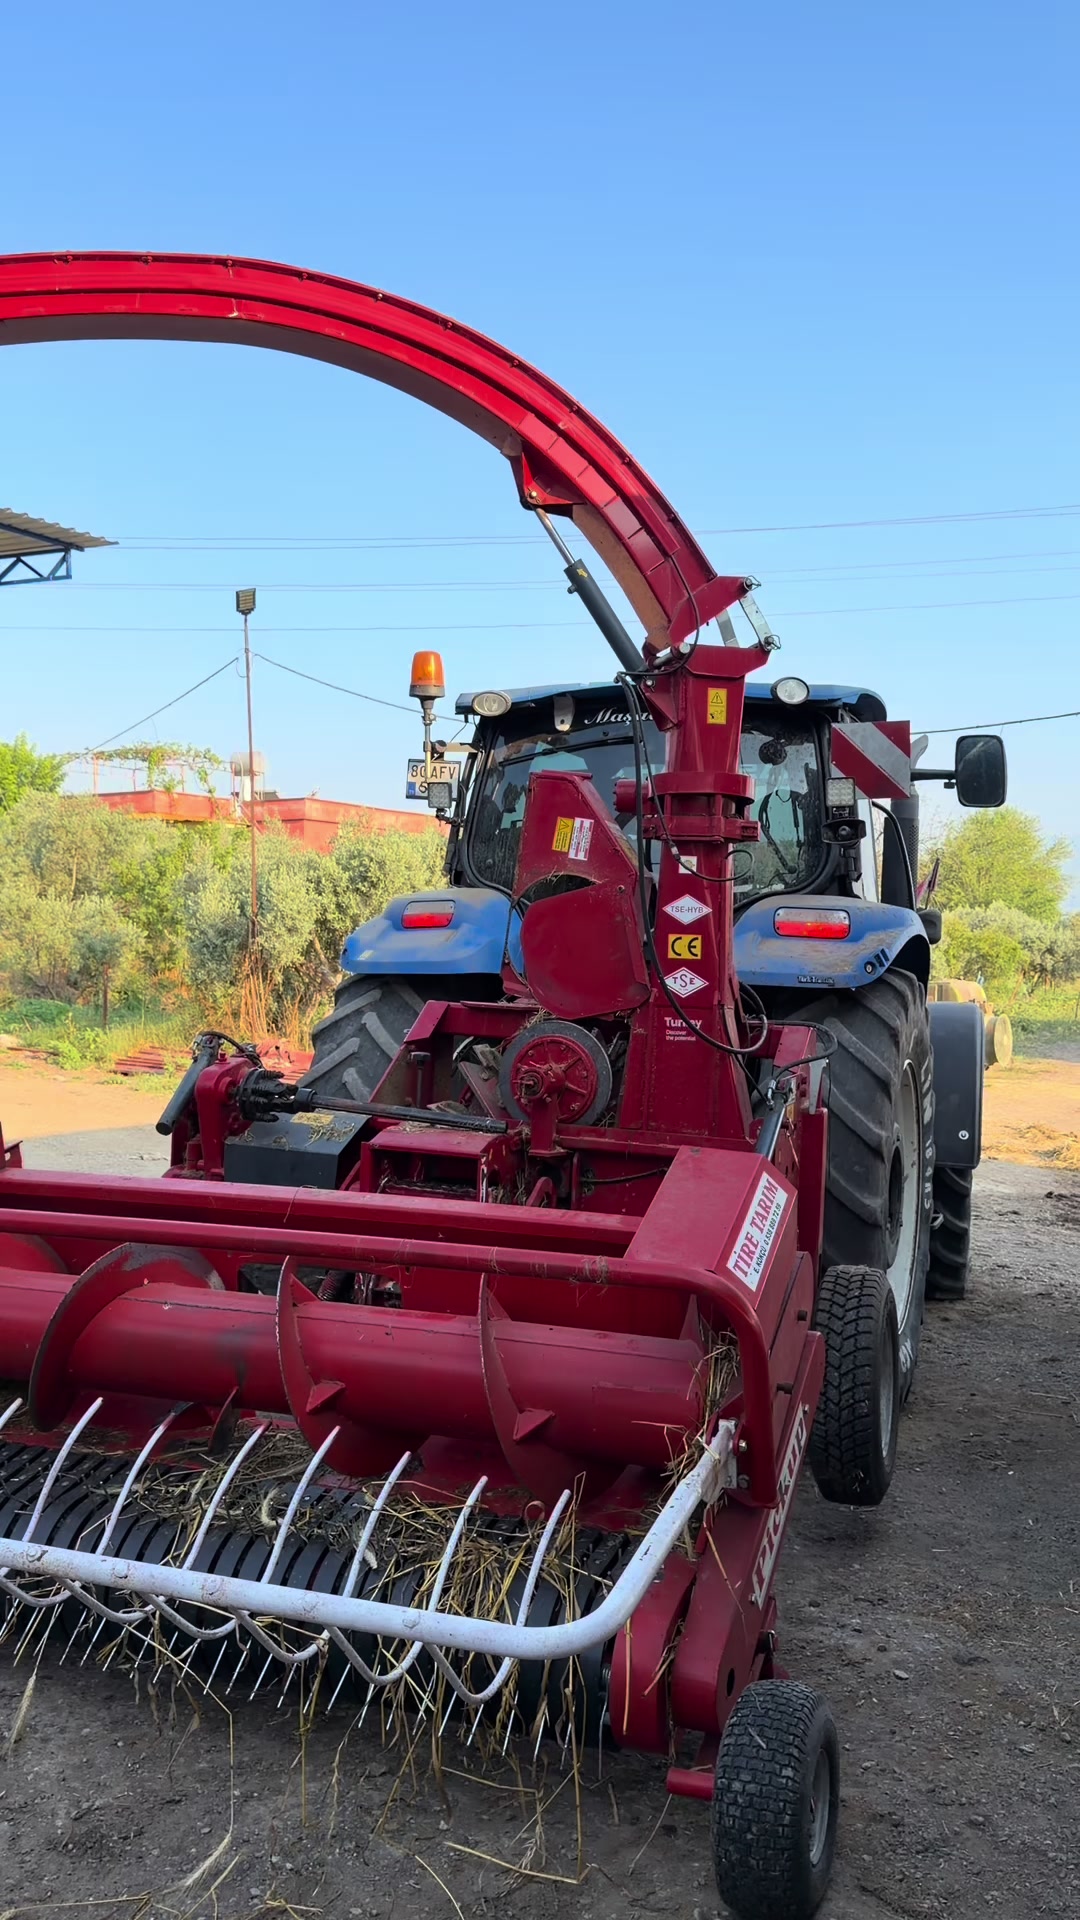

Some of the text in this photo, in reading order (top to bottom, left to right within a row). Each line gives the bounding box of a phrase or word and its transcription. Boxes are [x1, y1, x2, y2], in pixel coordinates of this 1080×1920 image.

[431, 765, 457, 780] AFV
[670, 905, 704, 914] TSE-HYB
[671, 936, 699, 957] CE
[672, 973, 696, 988] TSE
[749, 1178, 779, 1235] TARIM
